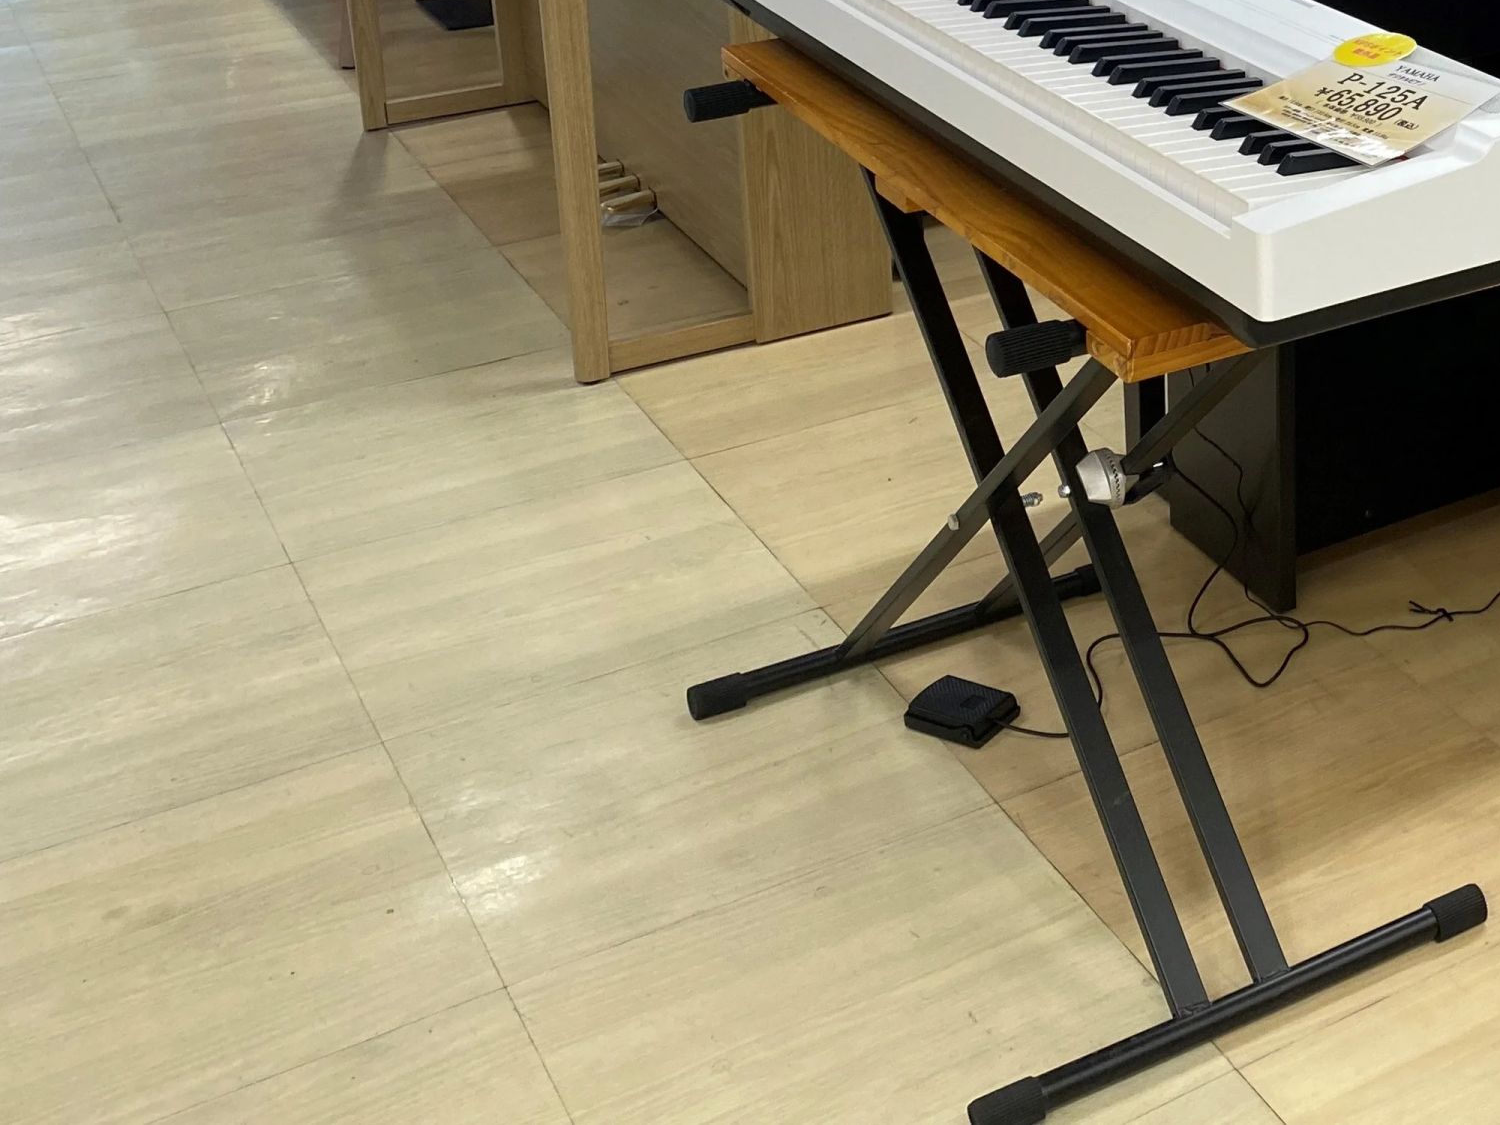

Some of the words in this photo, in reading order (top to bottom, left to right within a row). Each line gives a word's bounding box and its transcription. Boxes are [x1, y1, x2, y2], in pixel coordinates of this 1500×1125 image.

[1396, 65, 1440, 82] YAMAHA
[1314, 87, 1403, 122] ¥65,890
[1337, 73, 1429, 111] P-125A
